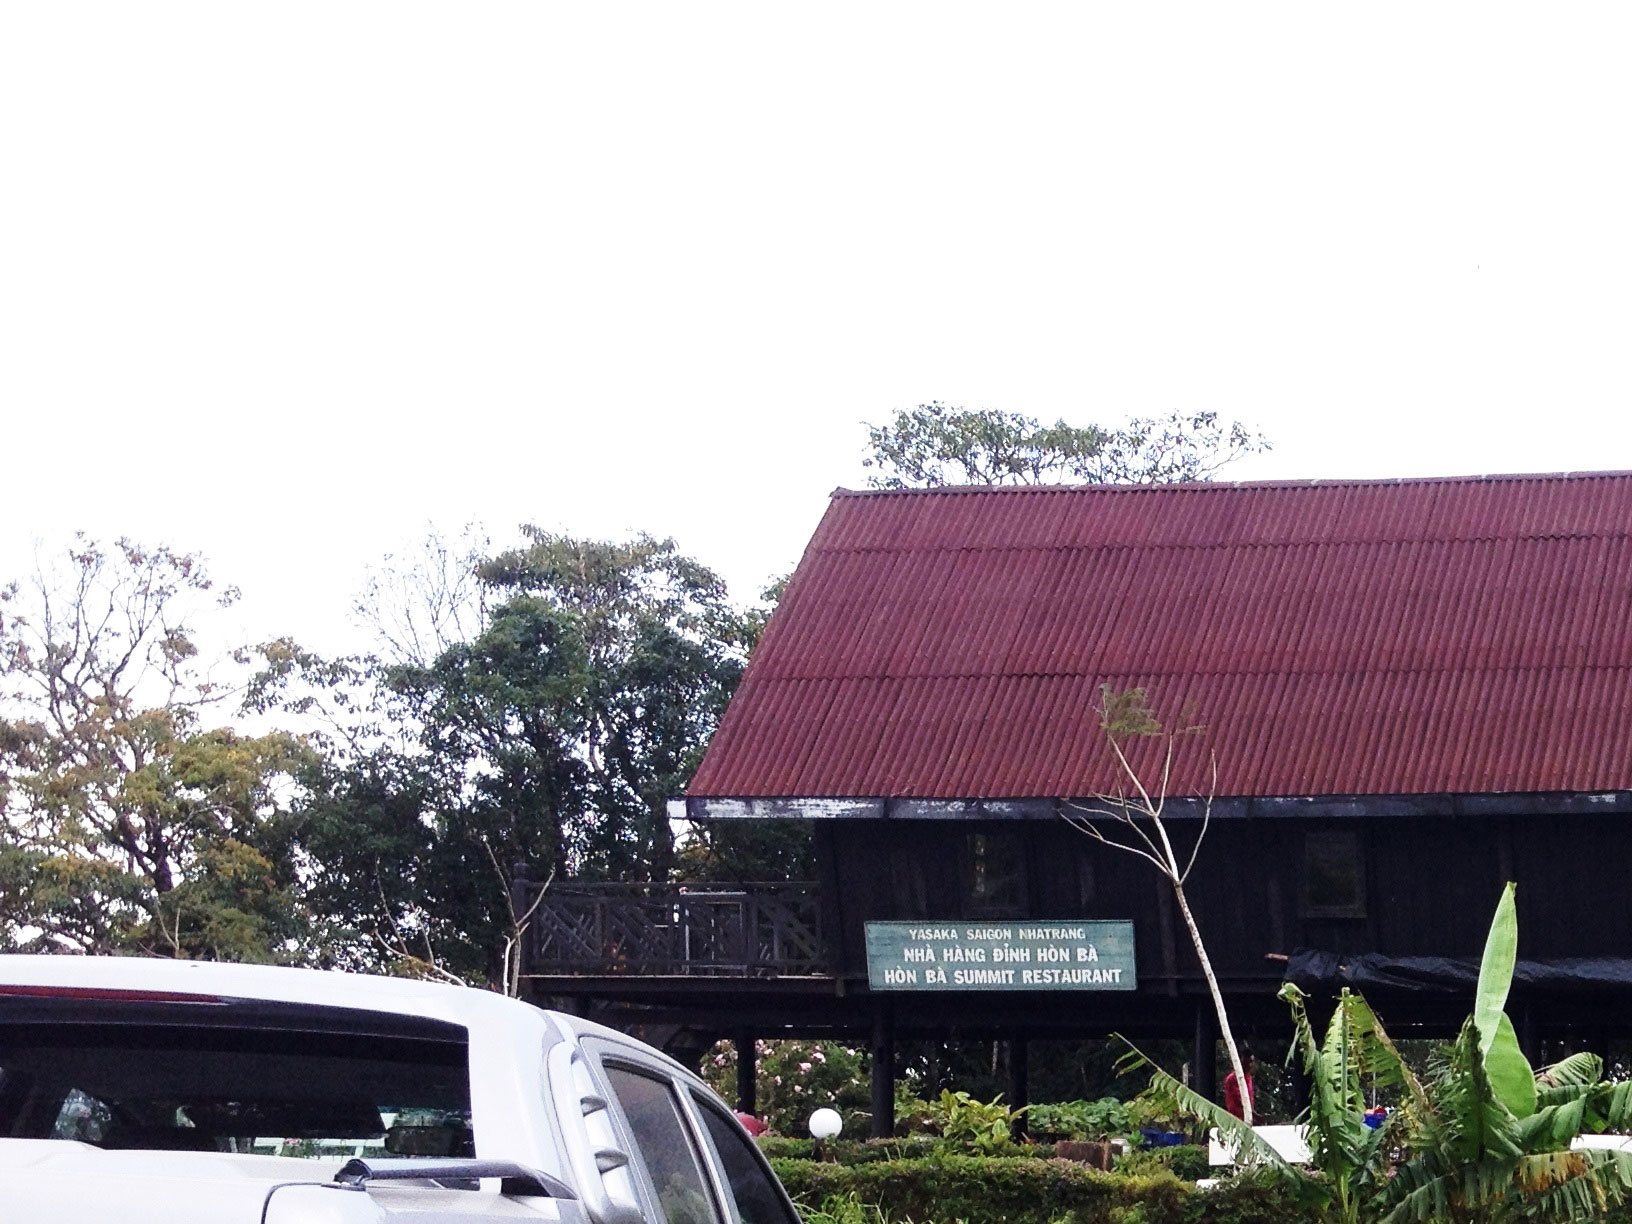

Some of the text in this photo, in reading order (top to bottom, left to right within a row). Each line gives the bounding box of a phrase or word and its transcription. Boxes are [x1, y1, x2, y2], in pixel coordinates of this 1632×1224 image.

[908, 928, 1086, 940] YASAKA SAIGON NHATRANG
[903, 942, 1099, 962] NHÀ HÀNG ĐỈNH HÒN BÀ
[884, 965, 1122, 984] HÒN BÀ SUMMIT RESTAURANT
